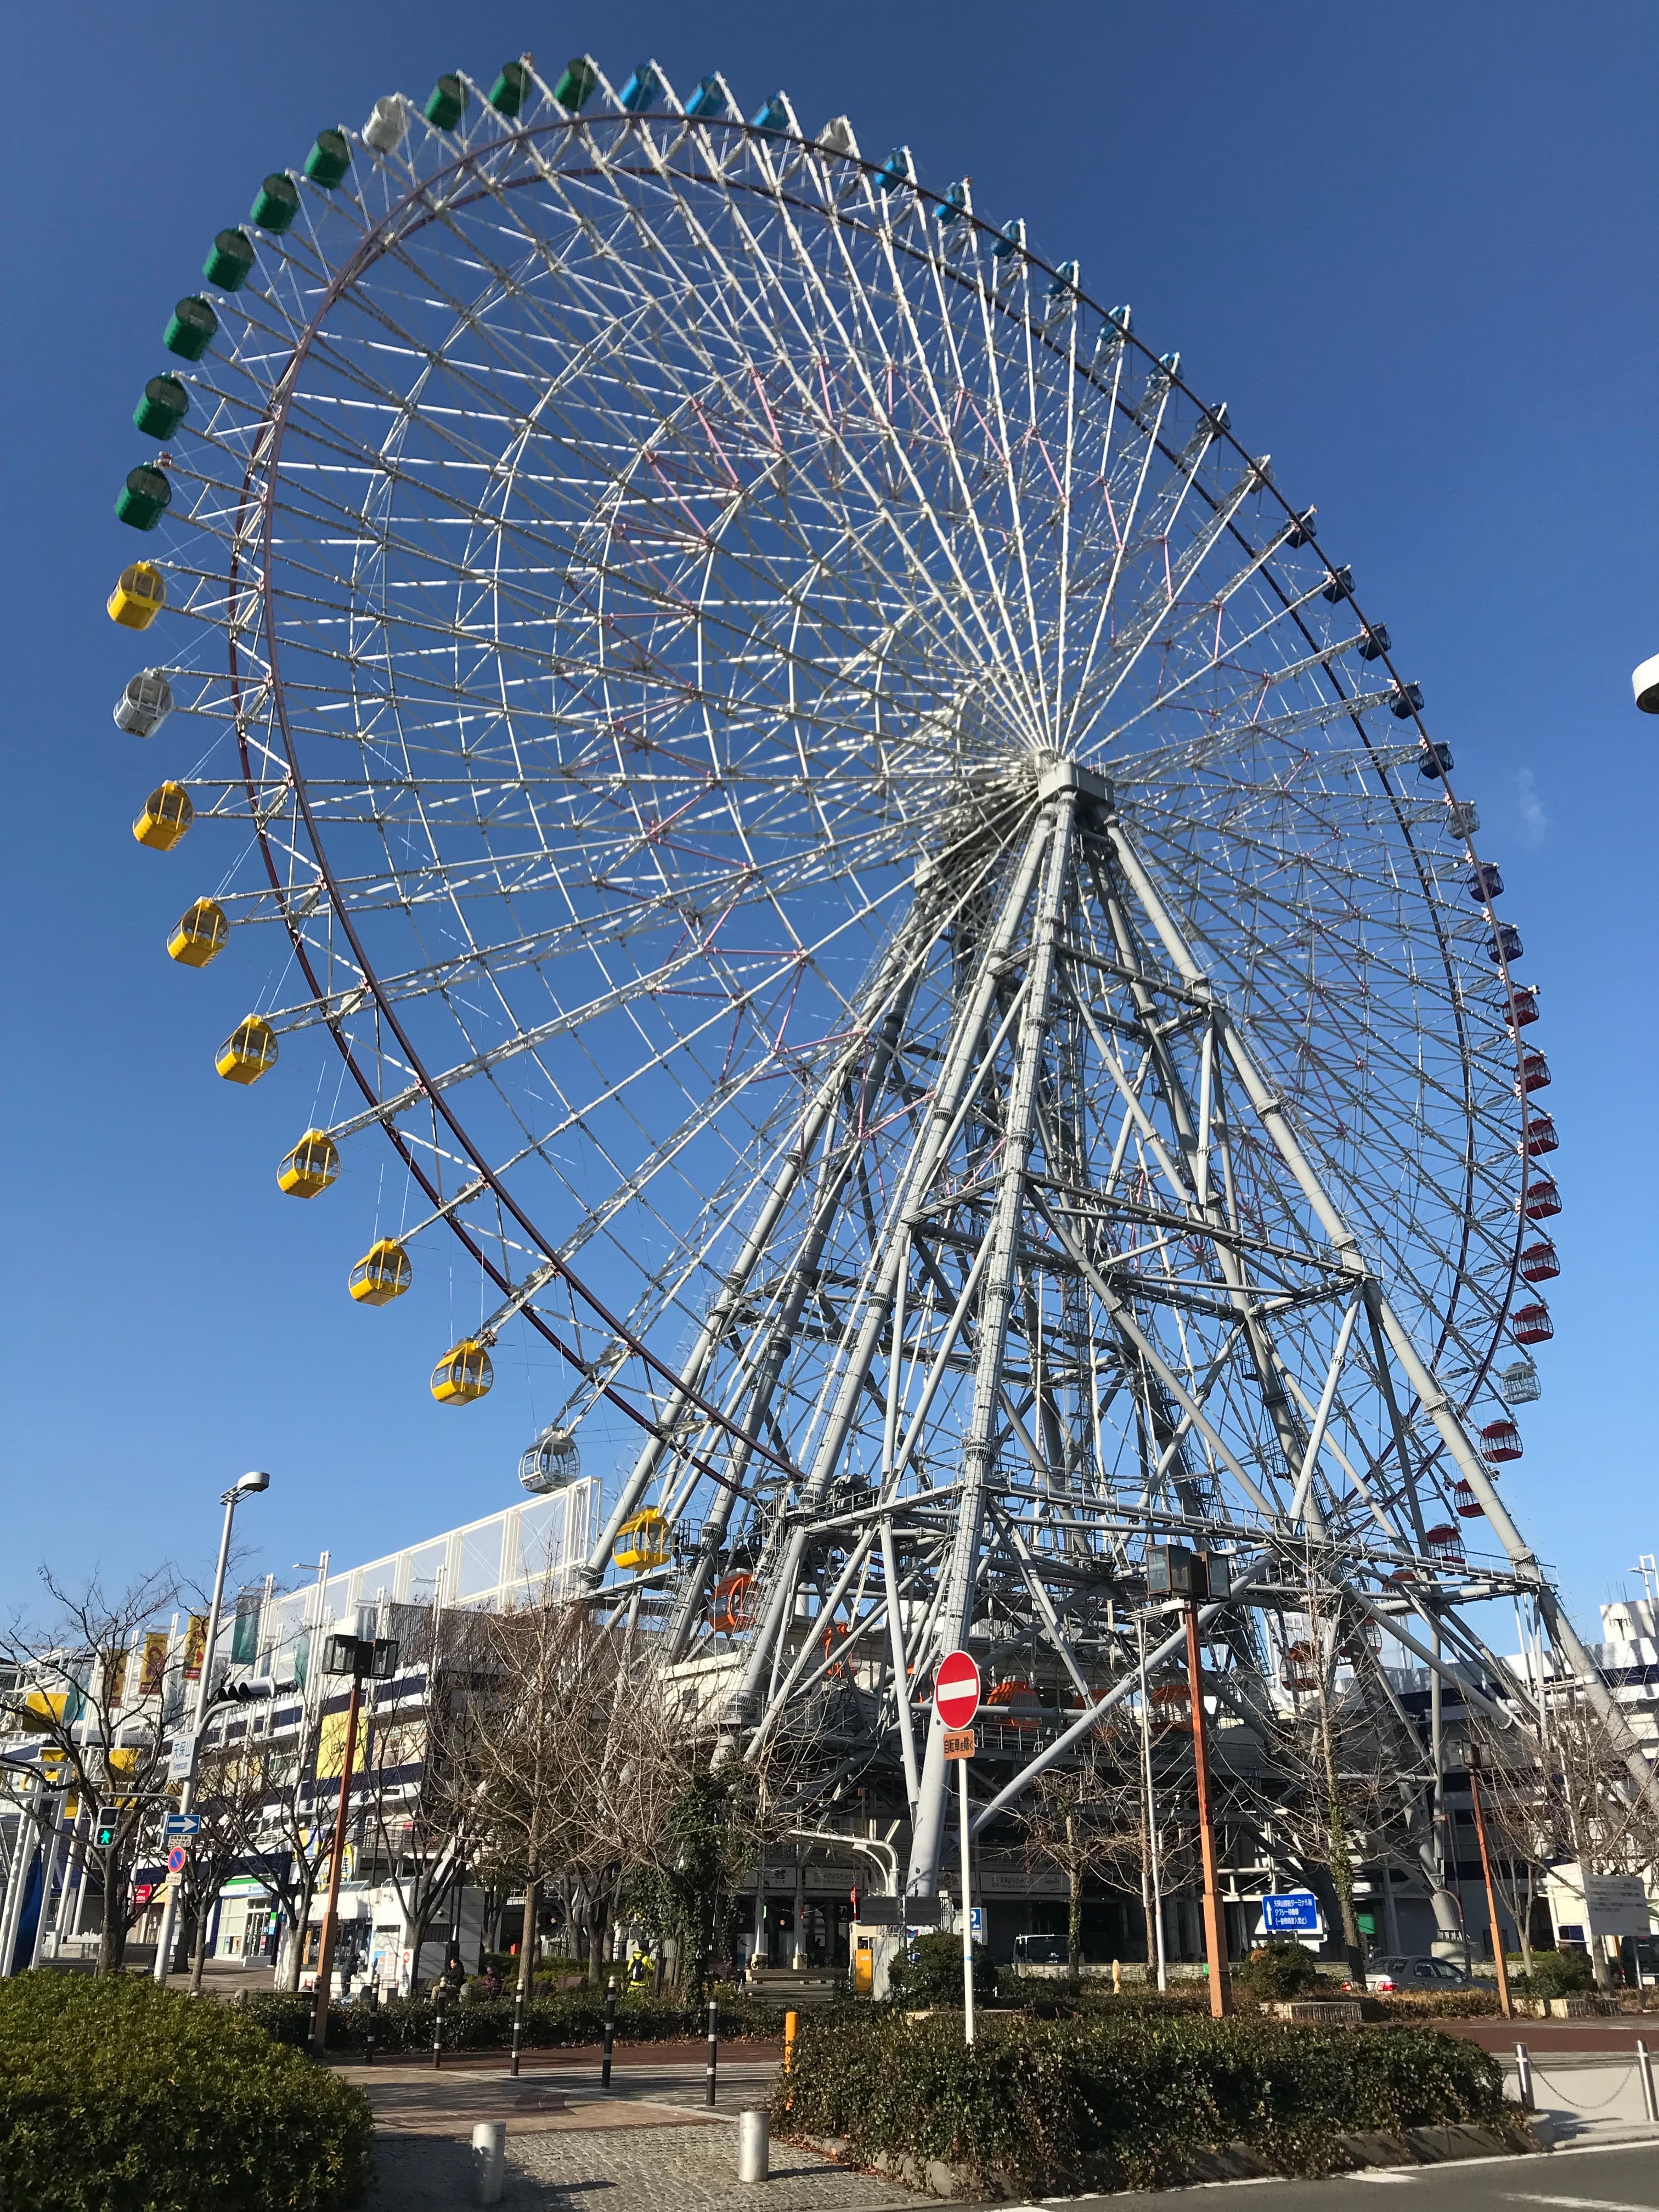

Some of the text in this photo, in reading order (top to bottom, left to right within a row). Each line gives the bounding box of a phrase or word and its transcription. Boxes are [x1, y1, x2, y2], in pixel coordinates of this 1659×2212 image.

[172, 1740, 193, 1759] 天保山
[944, 1736, 973, 1753] 自転車を除く
